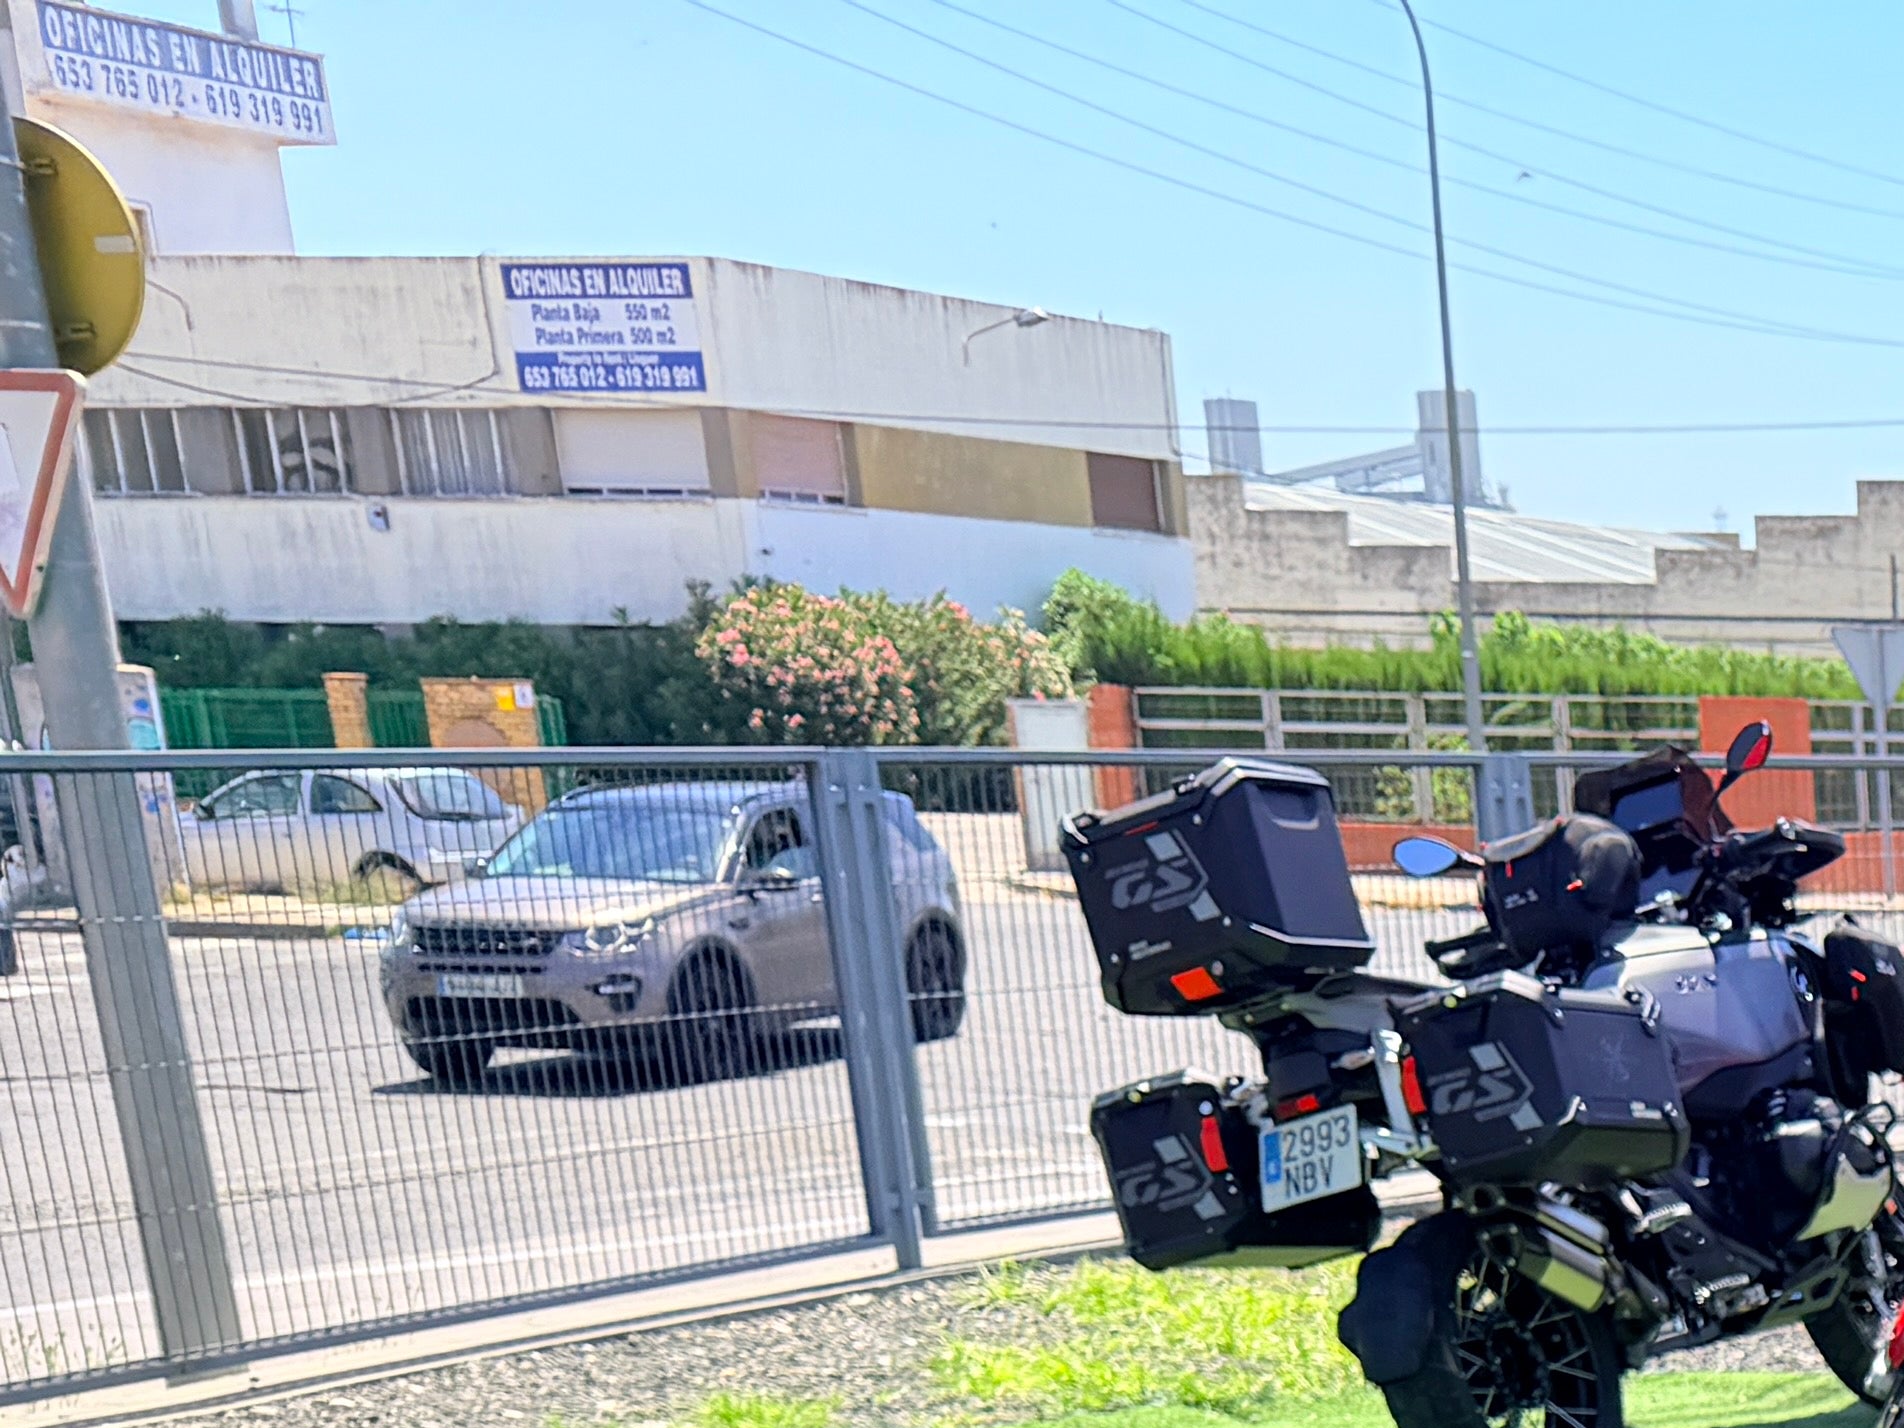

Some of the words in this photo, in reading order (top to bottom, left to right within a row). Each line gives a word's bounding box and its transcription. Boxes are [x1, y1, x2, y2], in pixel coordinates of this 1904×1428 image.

[44, 6, 161, 67] OFICINAS
[168, 34, 199, 73] EN
[209, 41, 322, 98] ALQUILER
[53, 55, 93, 91] 653
[100, 63, 140, 101] 765
[147, 73, 185, 108] 012
[205, 84, 241, 119] 619
[249, 93, 284, 127] 319
[290, 100, 323, 133] 991
[511, 268, 582, 296] OFICINAS
[583, 268, 606, 296] EN
[609, 267, 686, 296] ALQUILER
[531, 303, 570, 321] Planta
[574, 302, 600, 324] Baja
[650, 302, 671, 321] m2
[535, 327, 574, 345] Planta
[577, 327, 624, 345] Primera
[656, 326, 676, 345] m2
[524, 365, 550, 388] 653
[552, 365, 578, 388] 765
[579, 365, 609, 388] 012
[615, 365, 643, 388] 619
[645, 365, 671, 388] 319
[672, 365, 698, 388] 991
[1283, 1114, 1351, 1163] 2993
[1284, 1155, 1335, 1199] NBV
